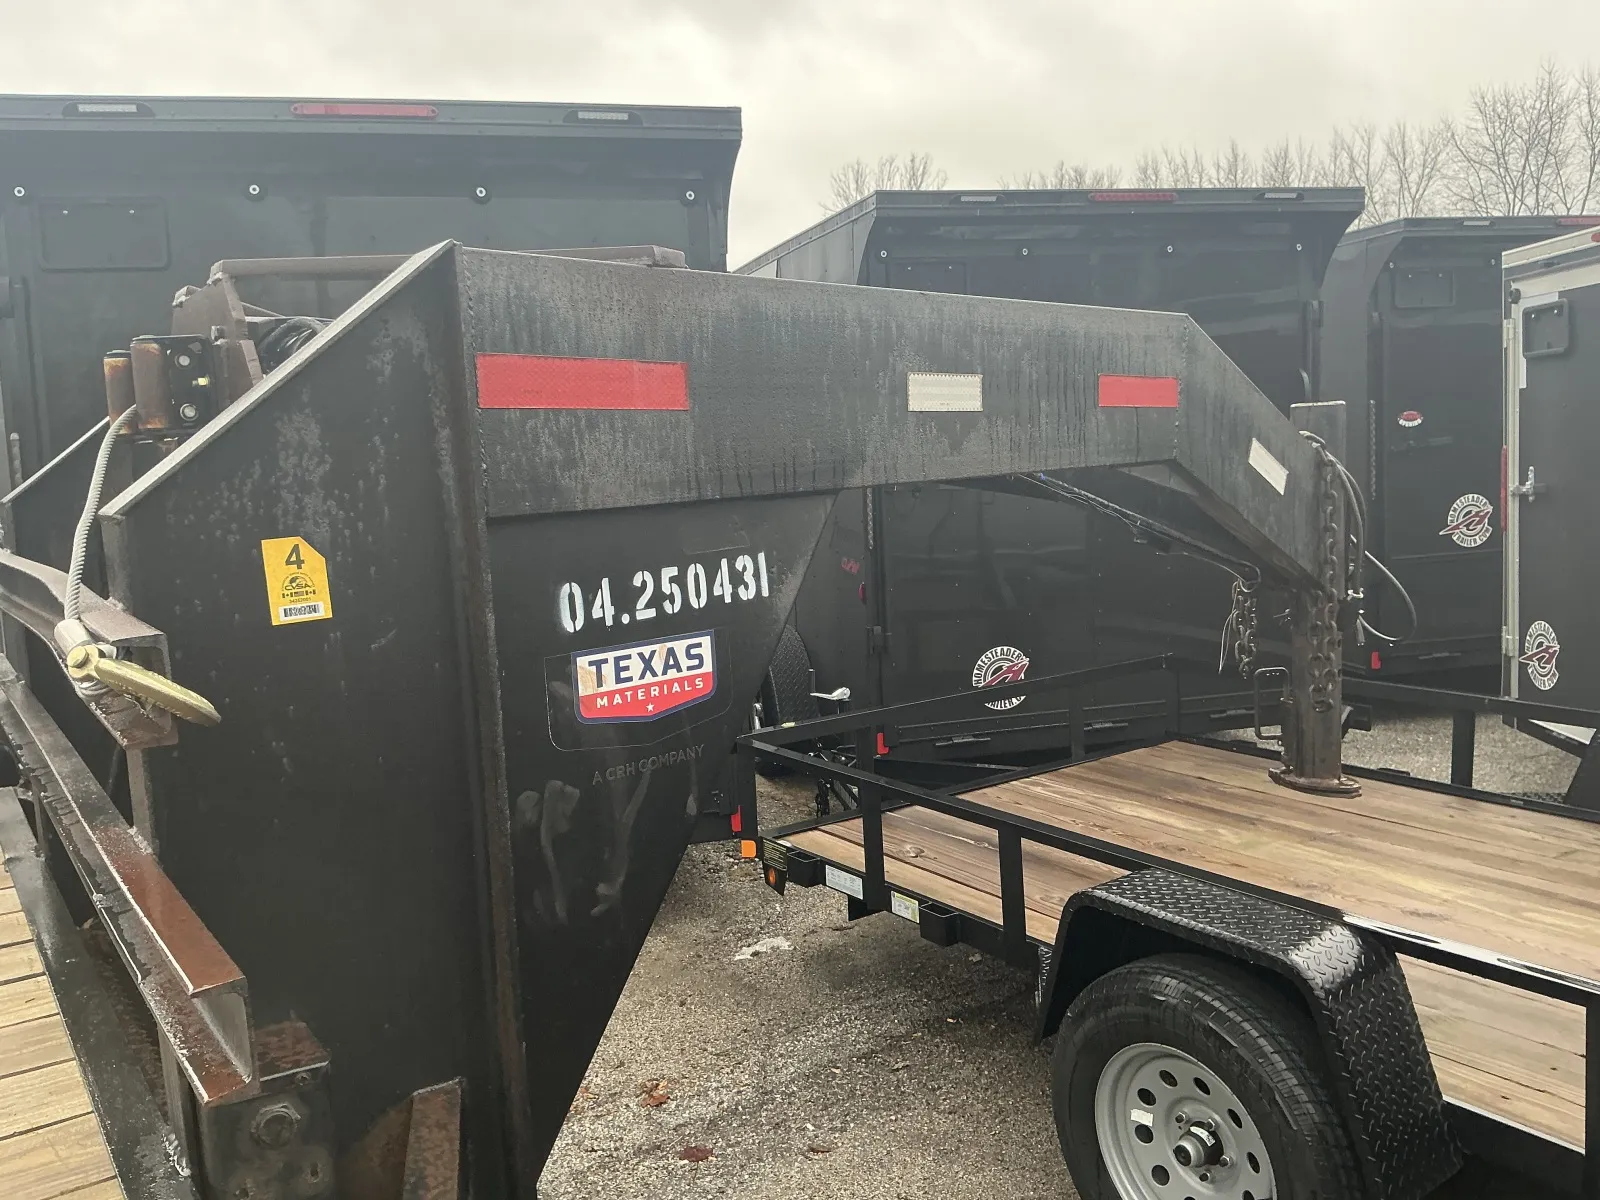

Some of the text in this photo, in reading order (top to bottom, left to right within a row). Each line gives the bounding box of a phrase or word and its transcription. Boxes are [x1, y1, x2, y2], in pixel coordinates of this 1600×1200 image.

[1448, 495, 1489, 525] HOMESTEADER
[285, 543, 305, 570] 4
[284, 583, 312, 591] CVSA
[559, 552, 770, 633] 04.250431
[588, 642, 704, 689] TEXAS
[973, 647, 1023, 685] HOMESTEADER
[596, 677, 704, 709] MATERIALS
[592, 743, 705, 785] A CRH COMPANY
